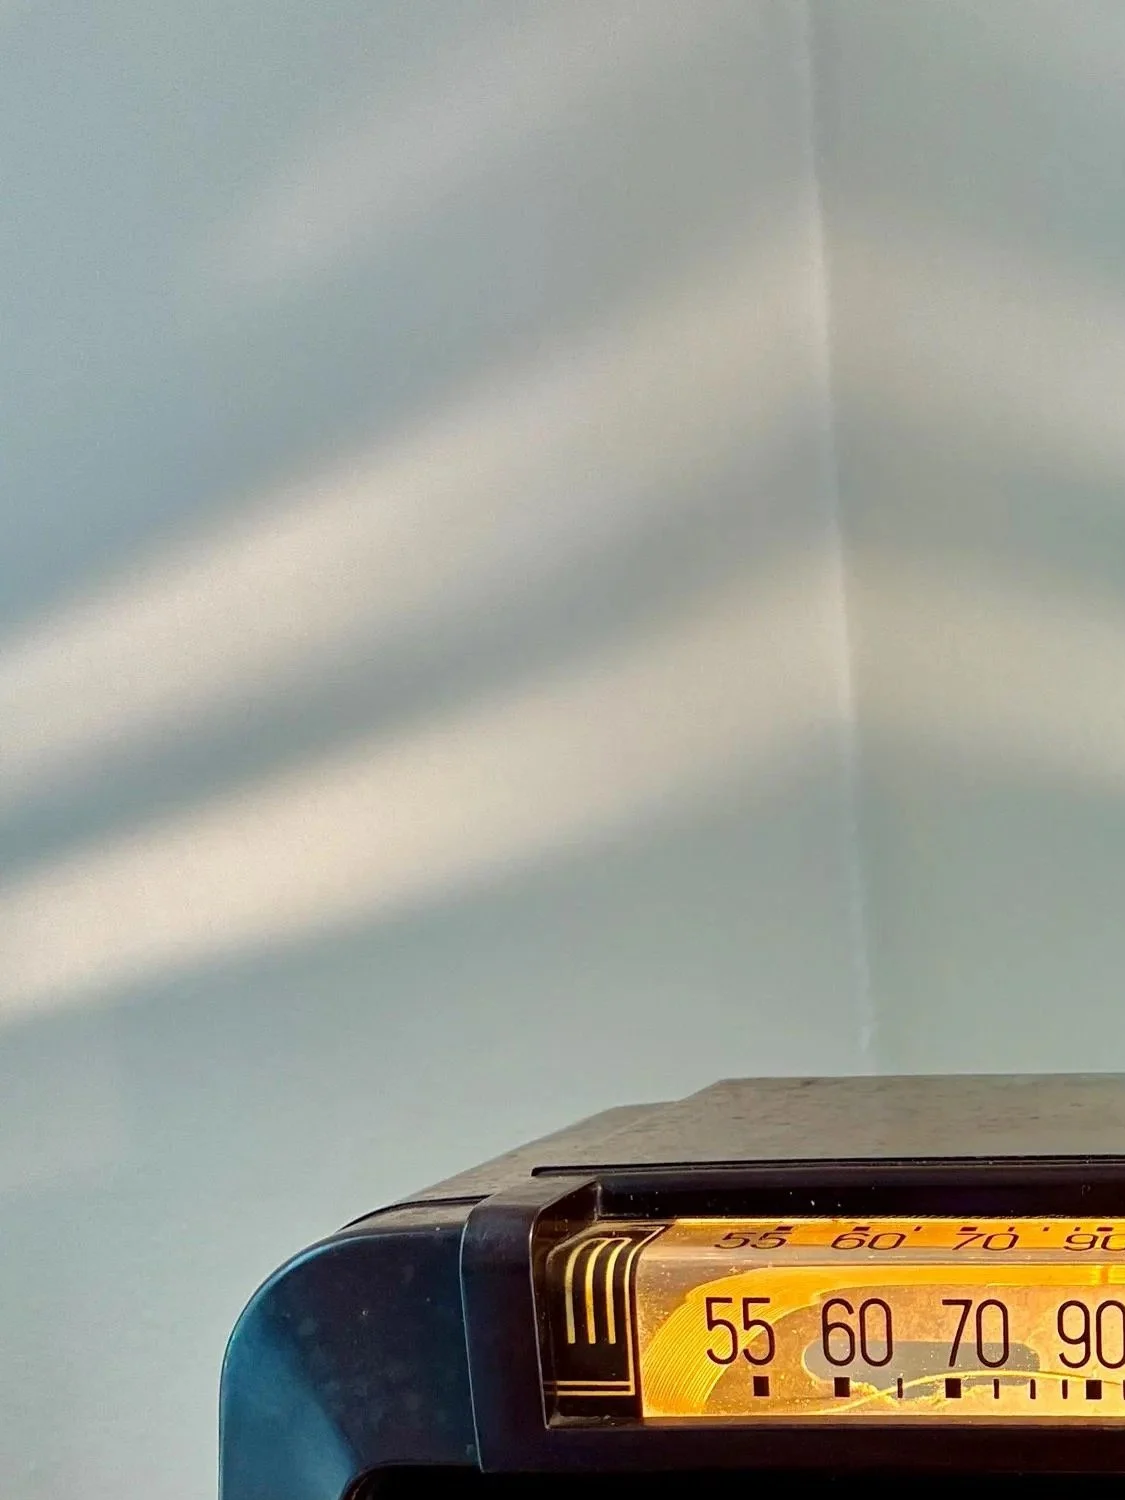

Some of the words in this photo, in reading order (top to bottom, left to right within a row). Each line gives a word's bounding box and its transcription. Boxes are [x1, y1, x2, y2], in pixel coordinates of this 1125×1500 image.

[713, 1231, 790, 1249] 55
[831, 1231, 906, 1251] 60
[951, 1231, 1020, 1251] 70
[705, 1297, 776, 1367] 55
[821, 1298, 893, 1367] 60
[941, 1299, 1010, 1368] 70
